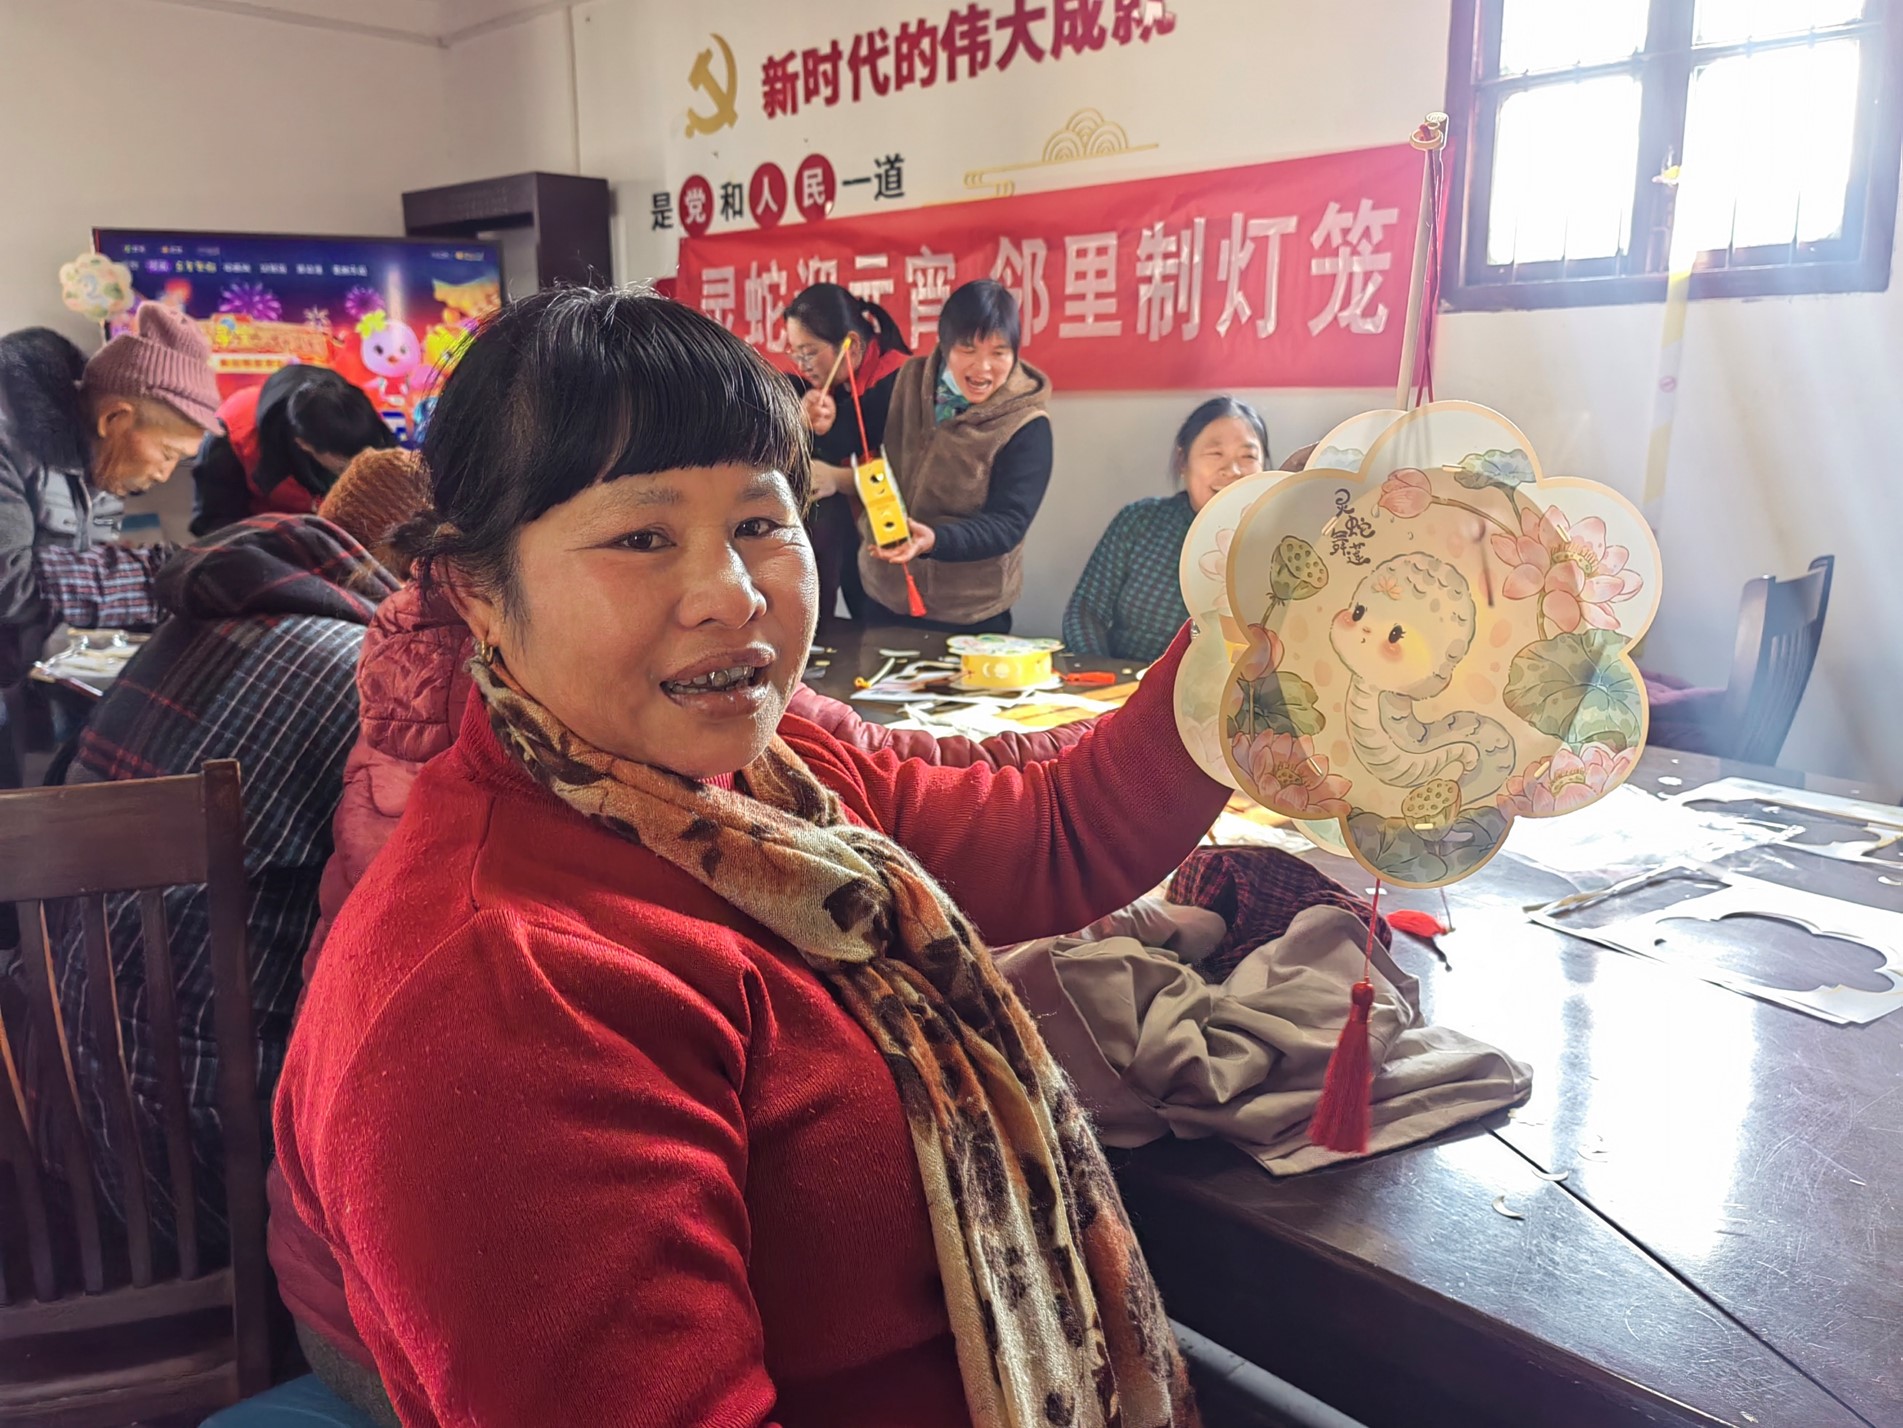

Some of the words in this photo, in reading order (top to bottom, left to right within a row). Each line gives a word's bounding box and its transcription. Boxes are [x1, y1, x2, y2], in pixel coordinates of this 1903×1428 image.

[651, 153, 905, 231] 是党和人民一道
